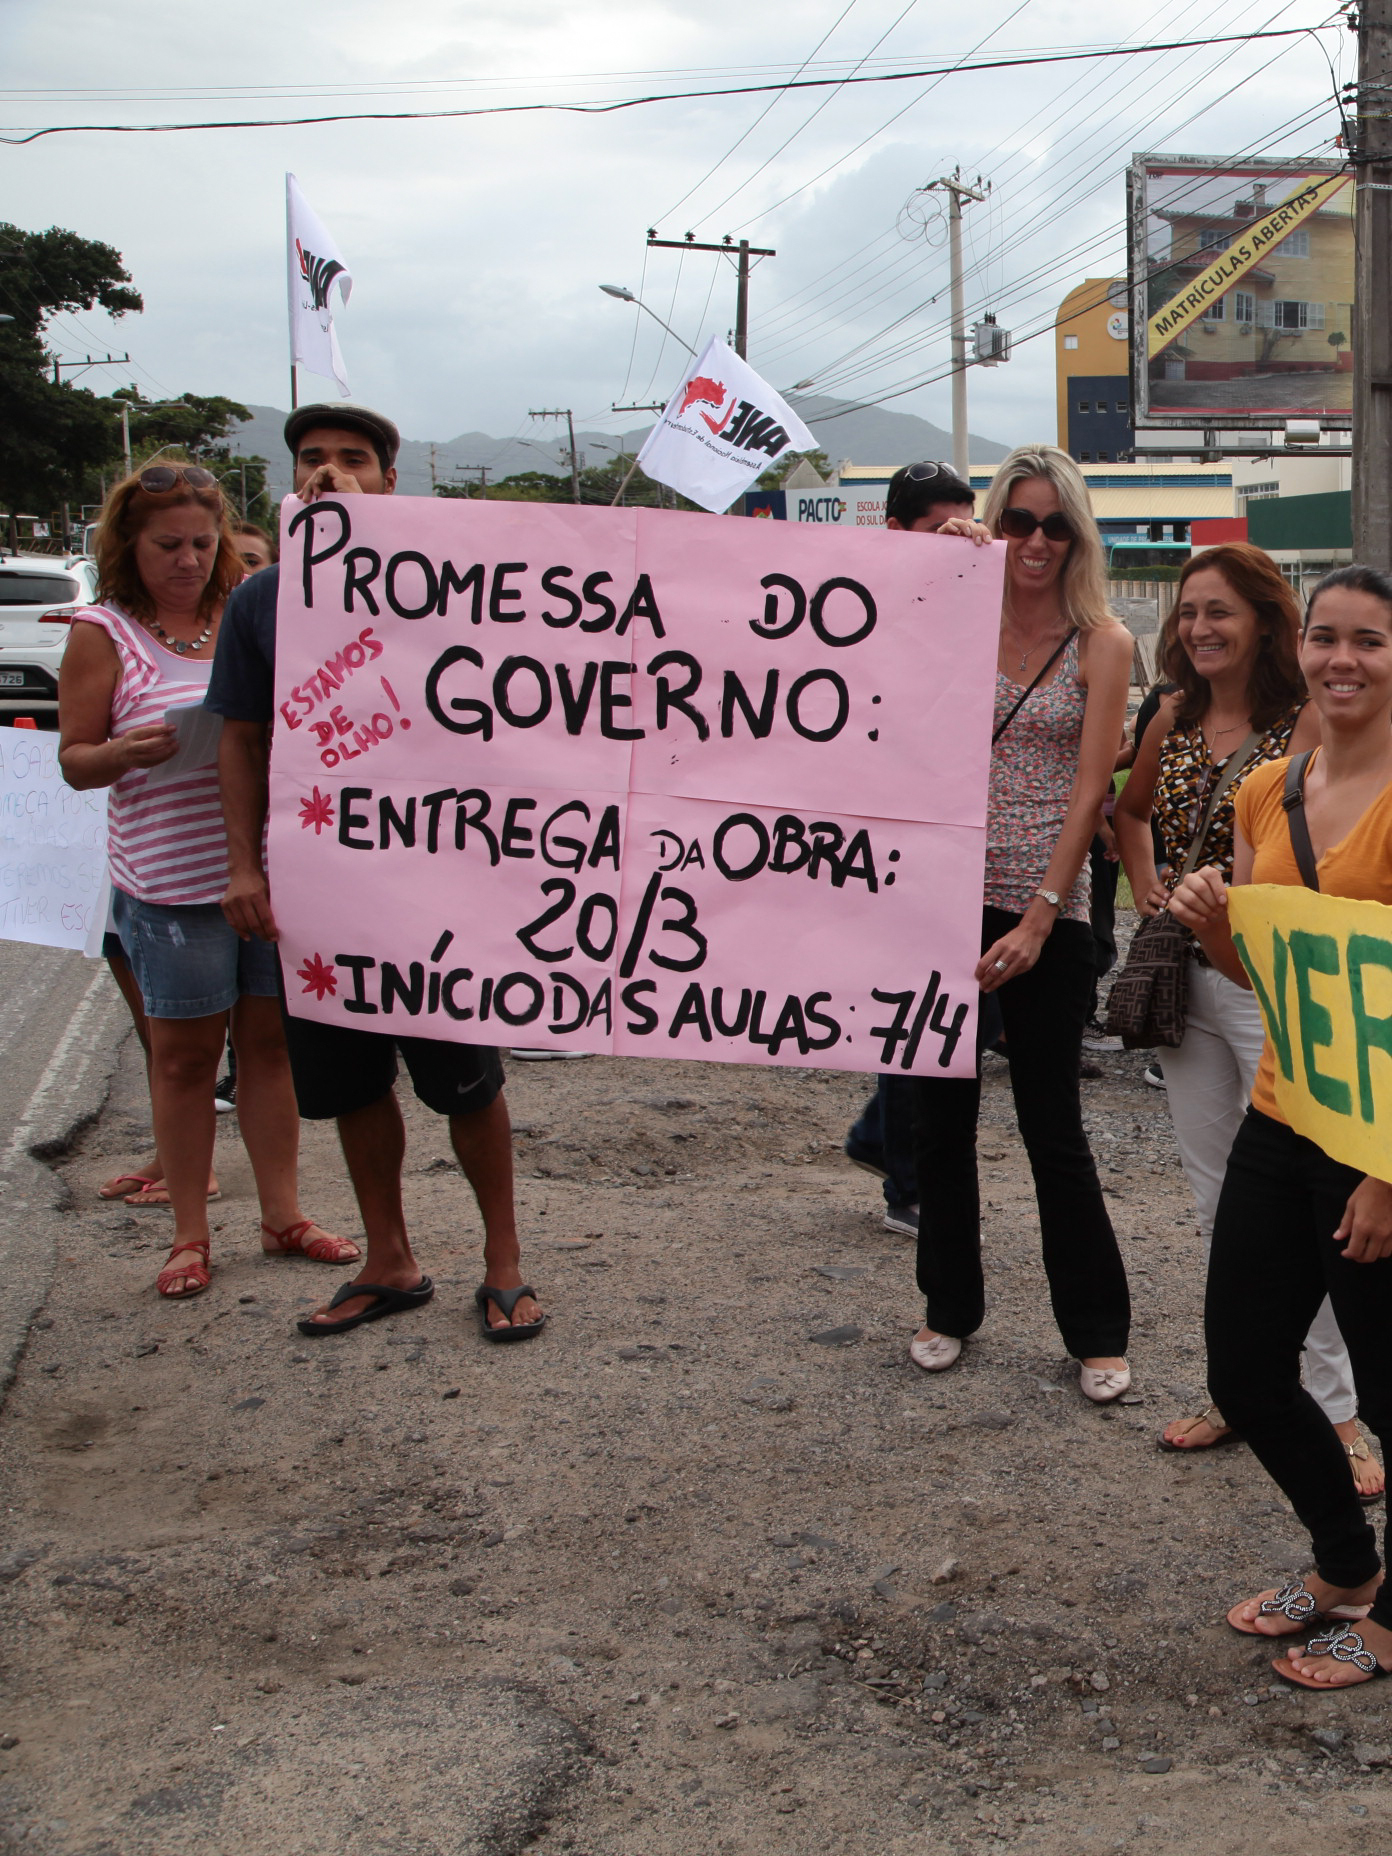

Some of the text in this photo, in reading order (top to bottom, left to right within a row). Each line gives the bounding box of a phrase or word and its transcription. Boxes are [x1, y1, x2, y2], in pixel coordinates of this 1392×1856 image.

[1154, 185, 1319, 337] MATRÍCULAS ABERTAS
[798, 496, 842, 523] PACTO
[856, 515, 866, 526] DO
[867, 515, 878, 525] SUL
[857, 501, 880, 512] ESCOLA
[289, 501, 879, 648] PROMESSA DO
[0, 675, 23, 685] 726
[280, 627, 384, 731] ESTAMOS
[308, 704, 355, 748] DE
[320, 675, 412, 769] OLHO!
[425, 645, 884, 743] GOVERNO:
[13, 740, 63, 779] SAB
[338, 785, 902, 894] ENTREGA DA OBRA:
[516, 872, 709, 979] 20/3
[335, 930, 970, 1069] INÍCIO DAS AULAS: 7/4
